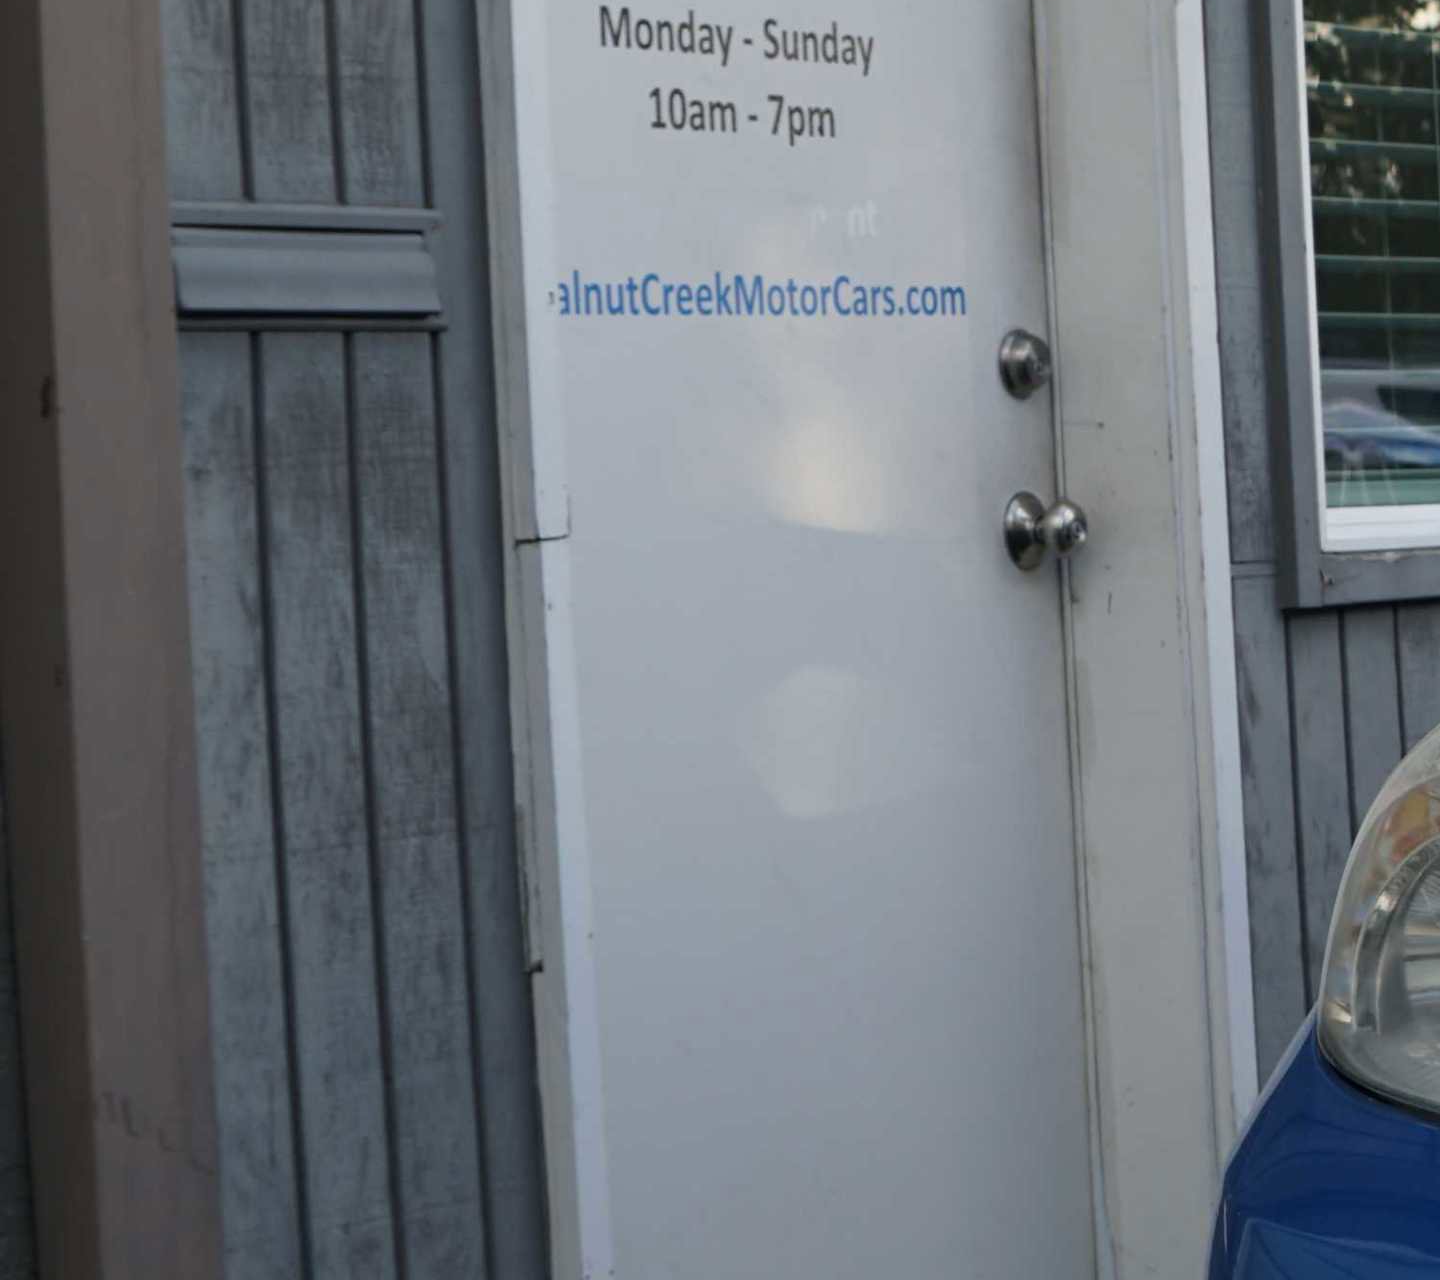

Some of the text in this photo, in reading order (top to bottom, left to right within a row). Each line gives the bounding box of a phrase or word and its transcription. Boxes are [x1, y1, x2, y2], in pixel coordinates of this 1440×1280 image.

[599, 4, 733, 68] Monday
[762, 18, 874, 77] Sunday
[649, 86, 738, 134] 10am
[767, 93, 836, 147] 7pm
[557, 270, 967, 316] alnutCreekMotorCars.com
